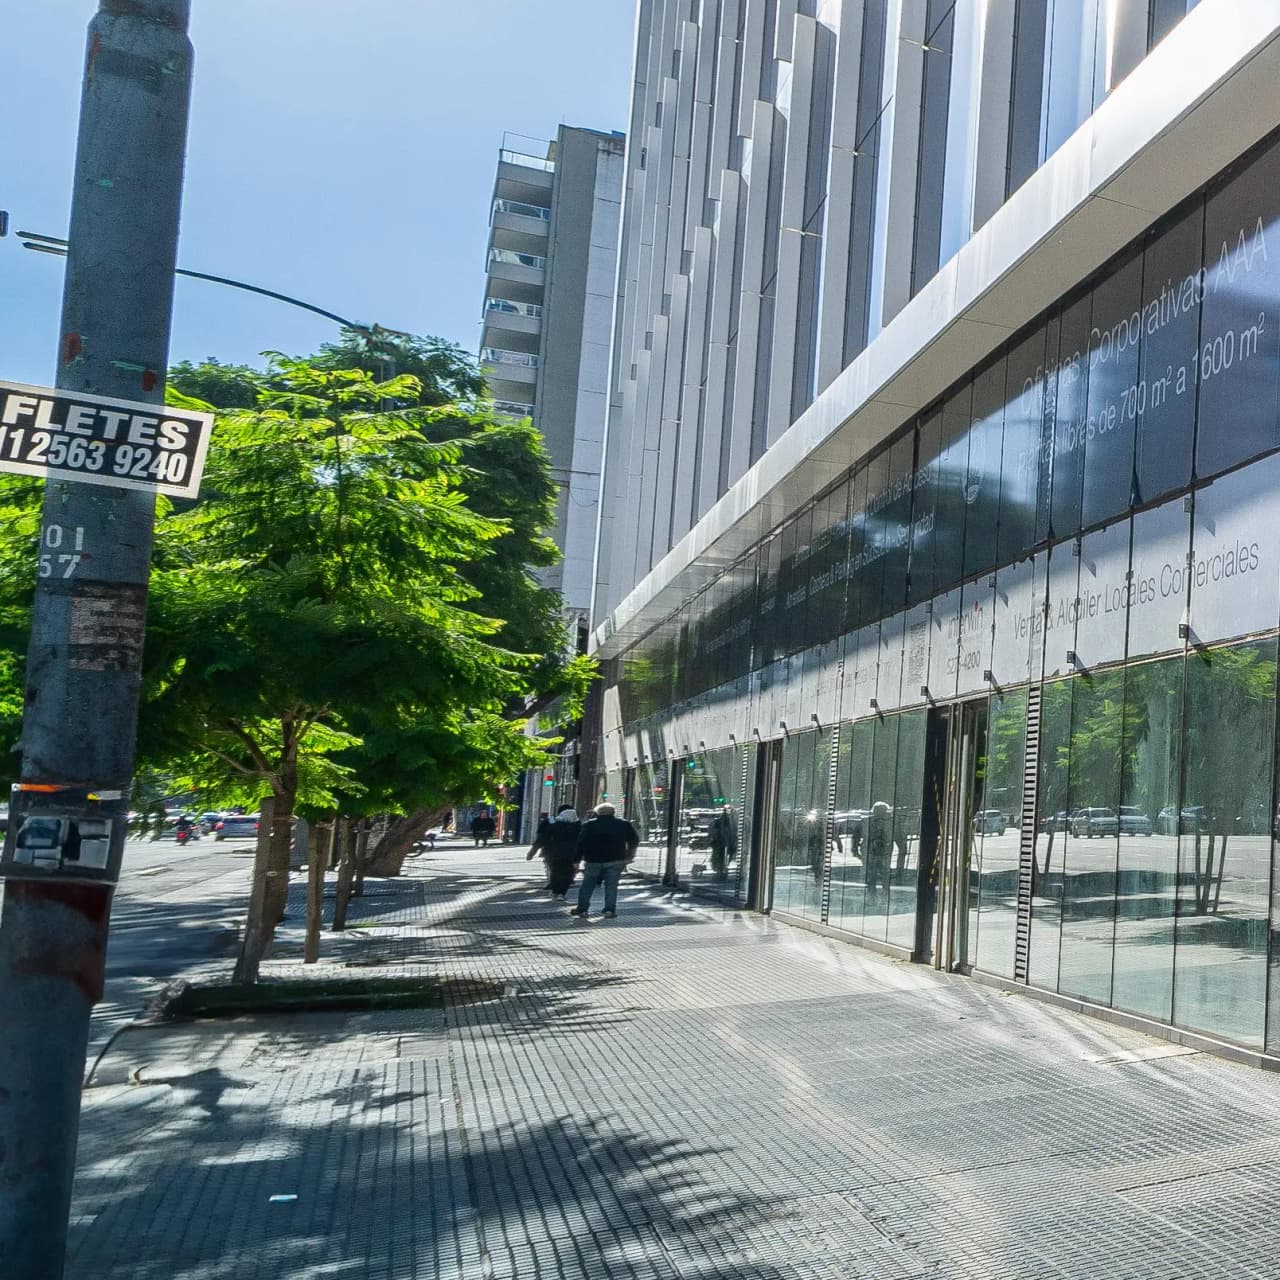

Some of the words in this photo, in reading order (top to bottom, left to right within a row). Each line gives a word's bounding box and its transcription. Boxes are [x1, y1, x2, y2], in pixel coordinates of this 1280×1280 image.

[1214, 215, 1268, 293] AAA
[3, 394, 190, 451] FLETES
[1099, 401, 1117, 435] de
[1119, 381, 1147, 424] 700
[112, 444, 188, 483] 9240
[1159, 539, 1260, 598] Comerciales
